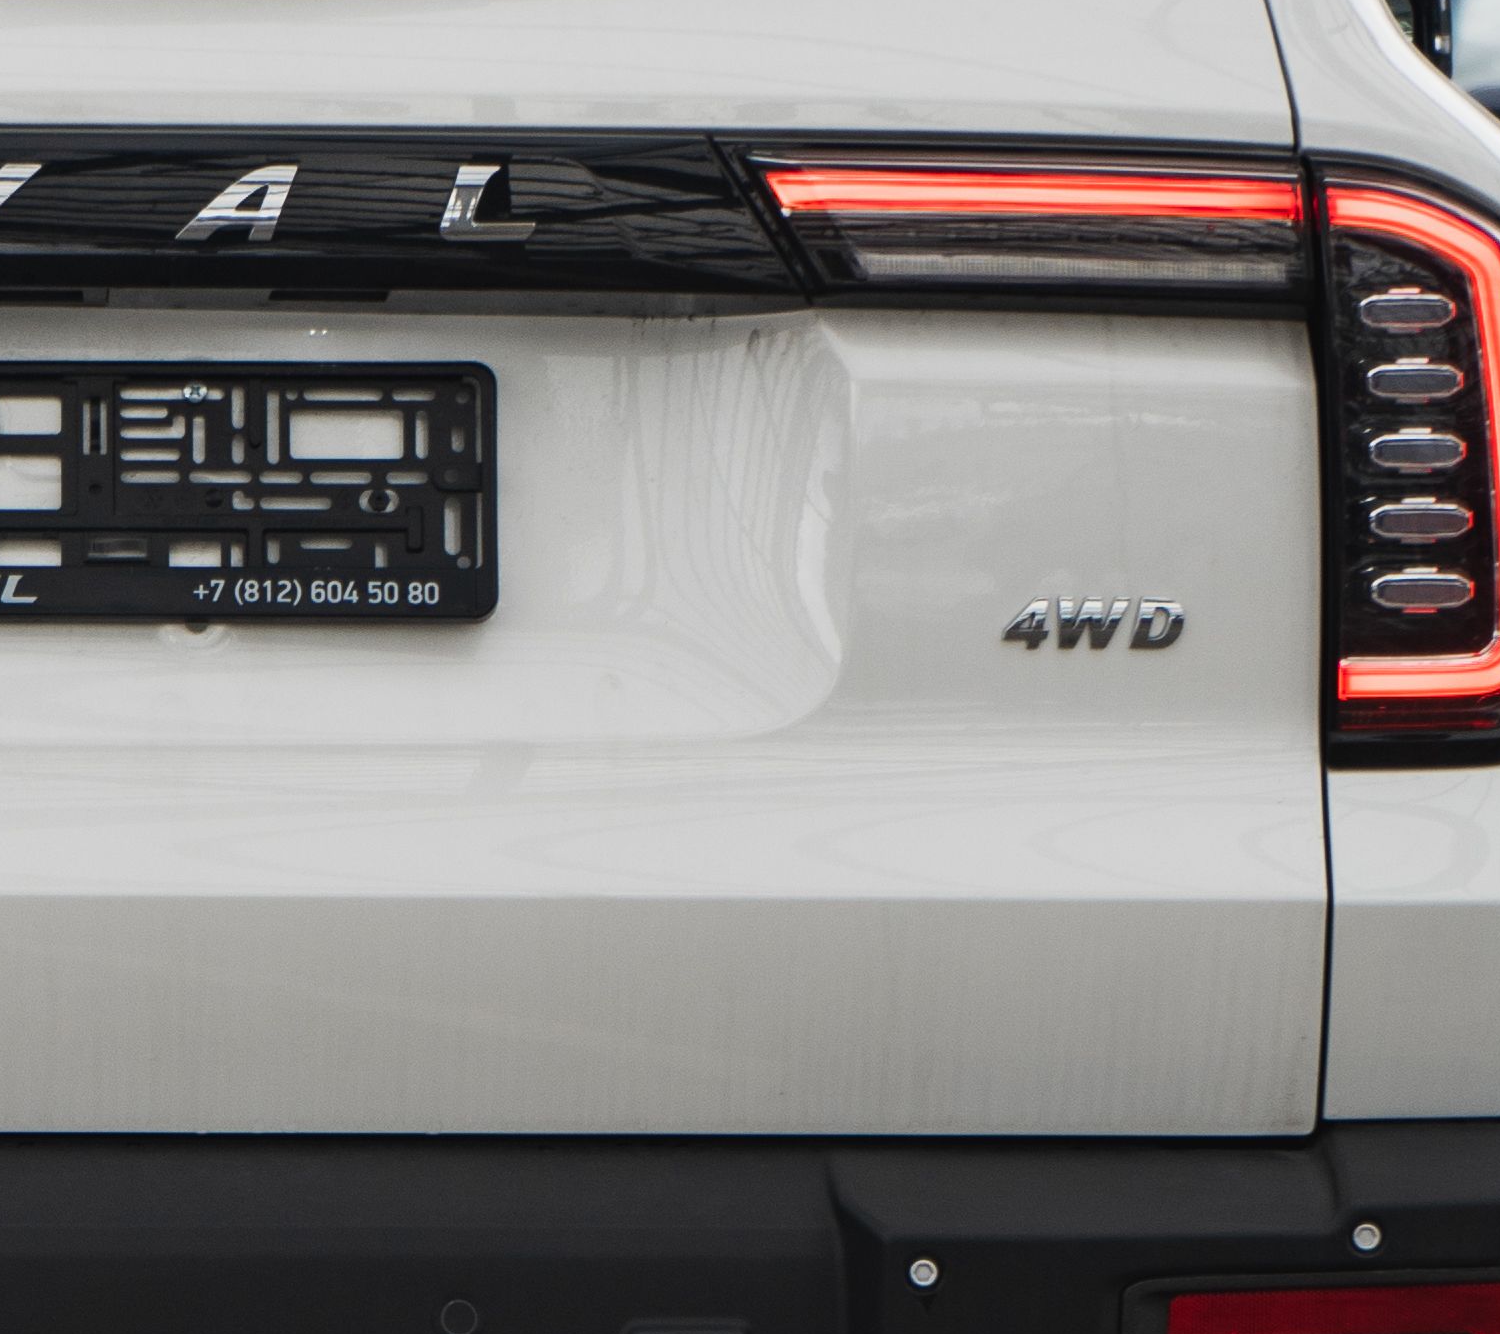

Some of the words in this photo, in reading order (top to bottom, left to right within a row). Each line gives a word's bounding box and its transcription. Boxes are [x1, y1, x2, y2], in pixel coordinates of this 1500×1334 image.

[192, 578, 226, 603] +7
[233, 577, 303, 606] (812)
[309, 579, 360, 605] 604
[366, 580, 400, 605] 50
[406, 581, 441, 606] 80
[1001, 595, 1187, 652] 4WD
